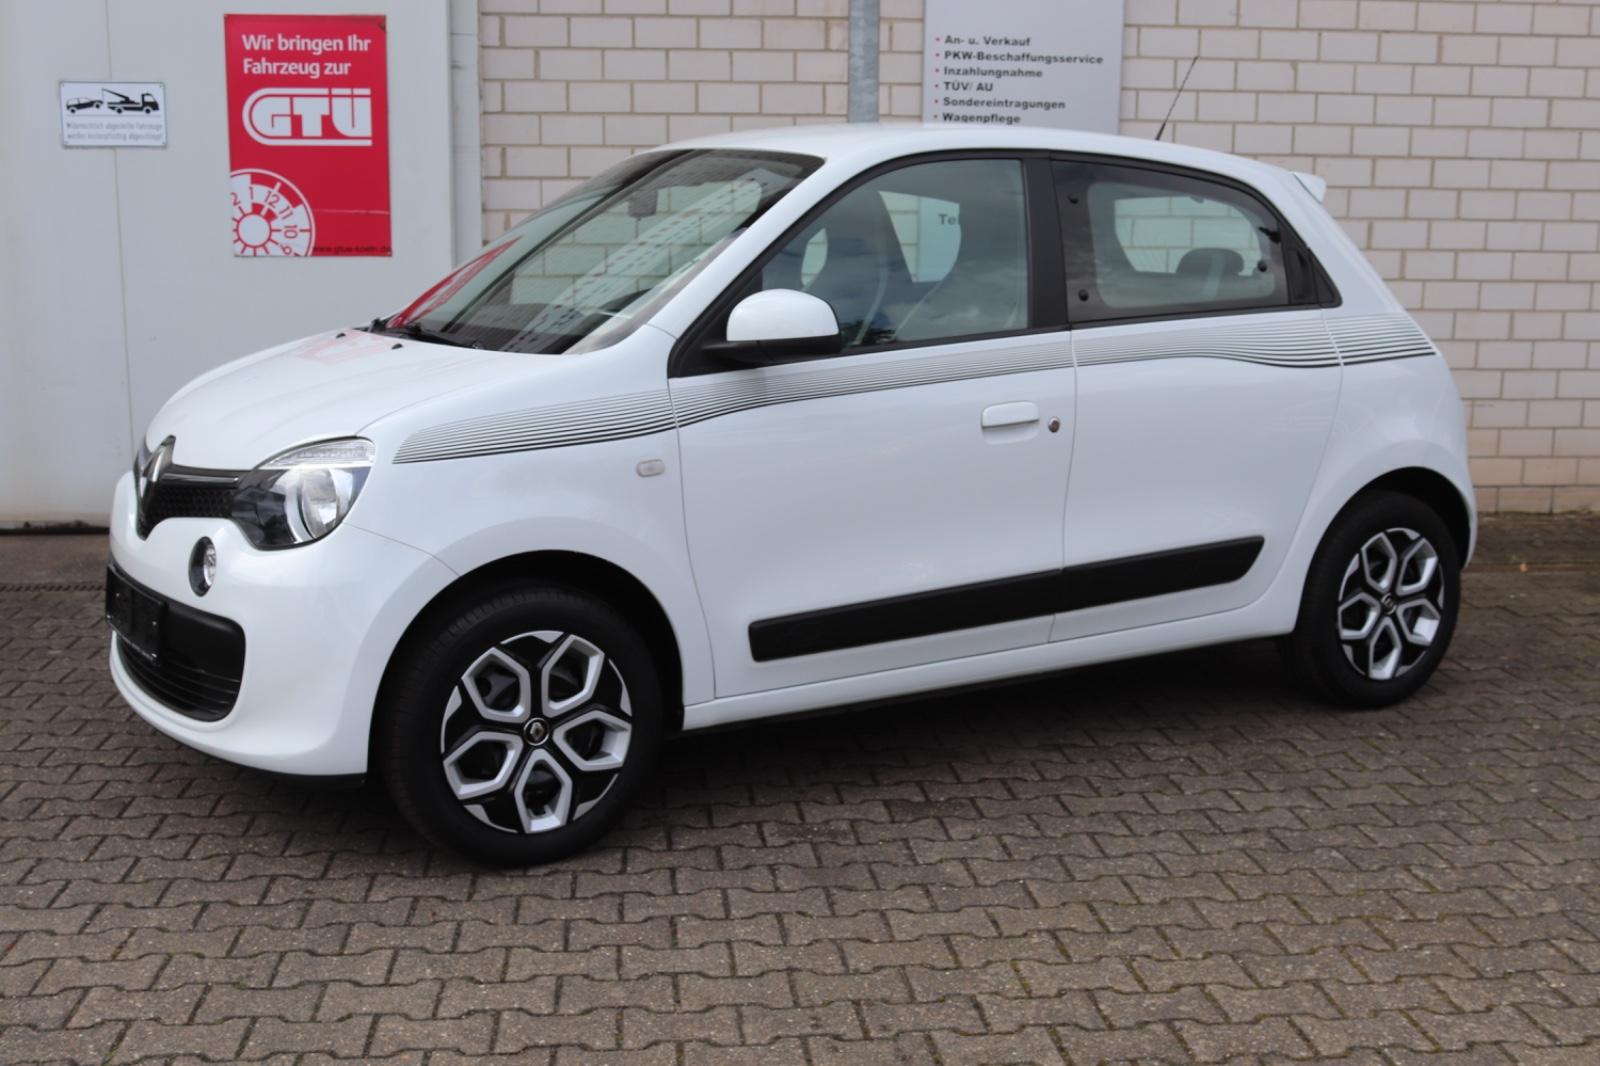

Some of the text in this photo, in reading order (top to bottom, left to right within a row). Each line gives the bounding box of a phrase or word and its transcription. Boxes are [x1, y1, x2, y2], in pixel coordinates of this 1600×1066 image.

[241, 34, 371, 55] Wir bringen Ihr
[944, 35, 1031, 47] An- u. Verkauf
[944, 51, 1104, 65] PKW-Beschaffungsservice
[243, 58, 351, 79] Fahrzeug zur
[944, 66, 1043, 79] Inzahlungnahme
[976, 82, 993, 92] AU
[943, 97, 1066, 110] Sondereintragungen
[242, 87, 373, 147] GTÜ
[942, 112, 1021, 125] Wagenpflege
[263, 190, 280, 208] 12
[283, 224, 298, 239] 10
